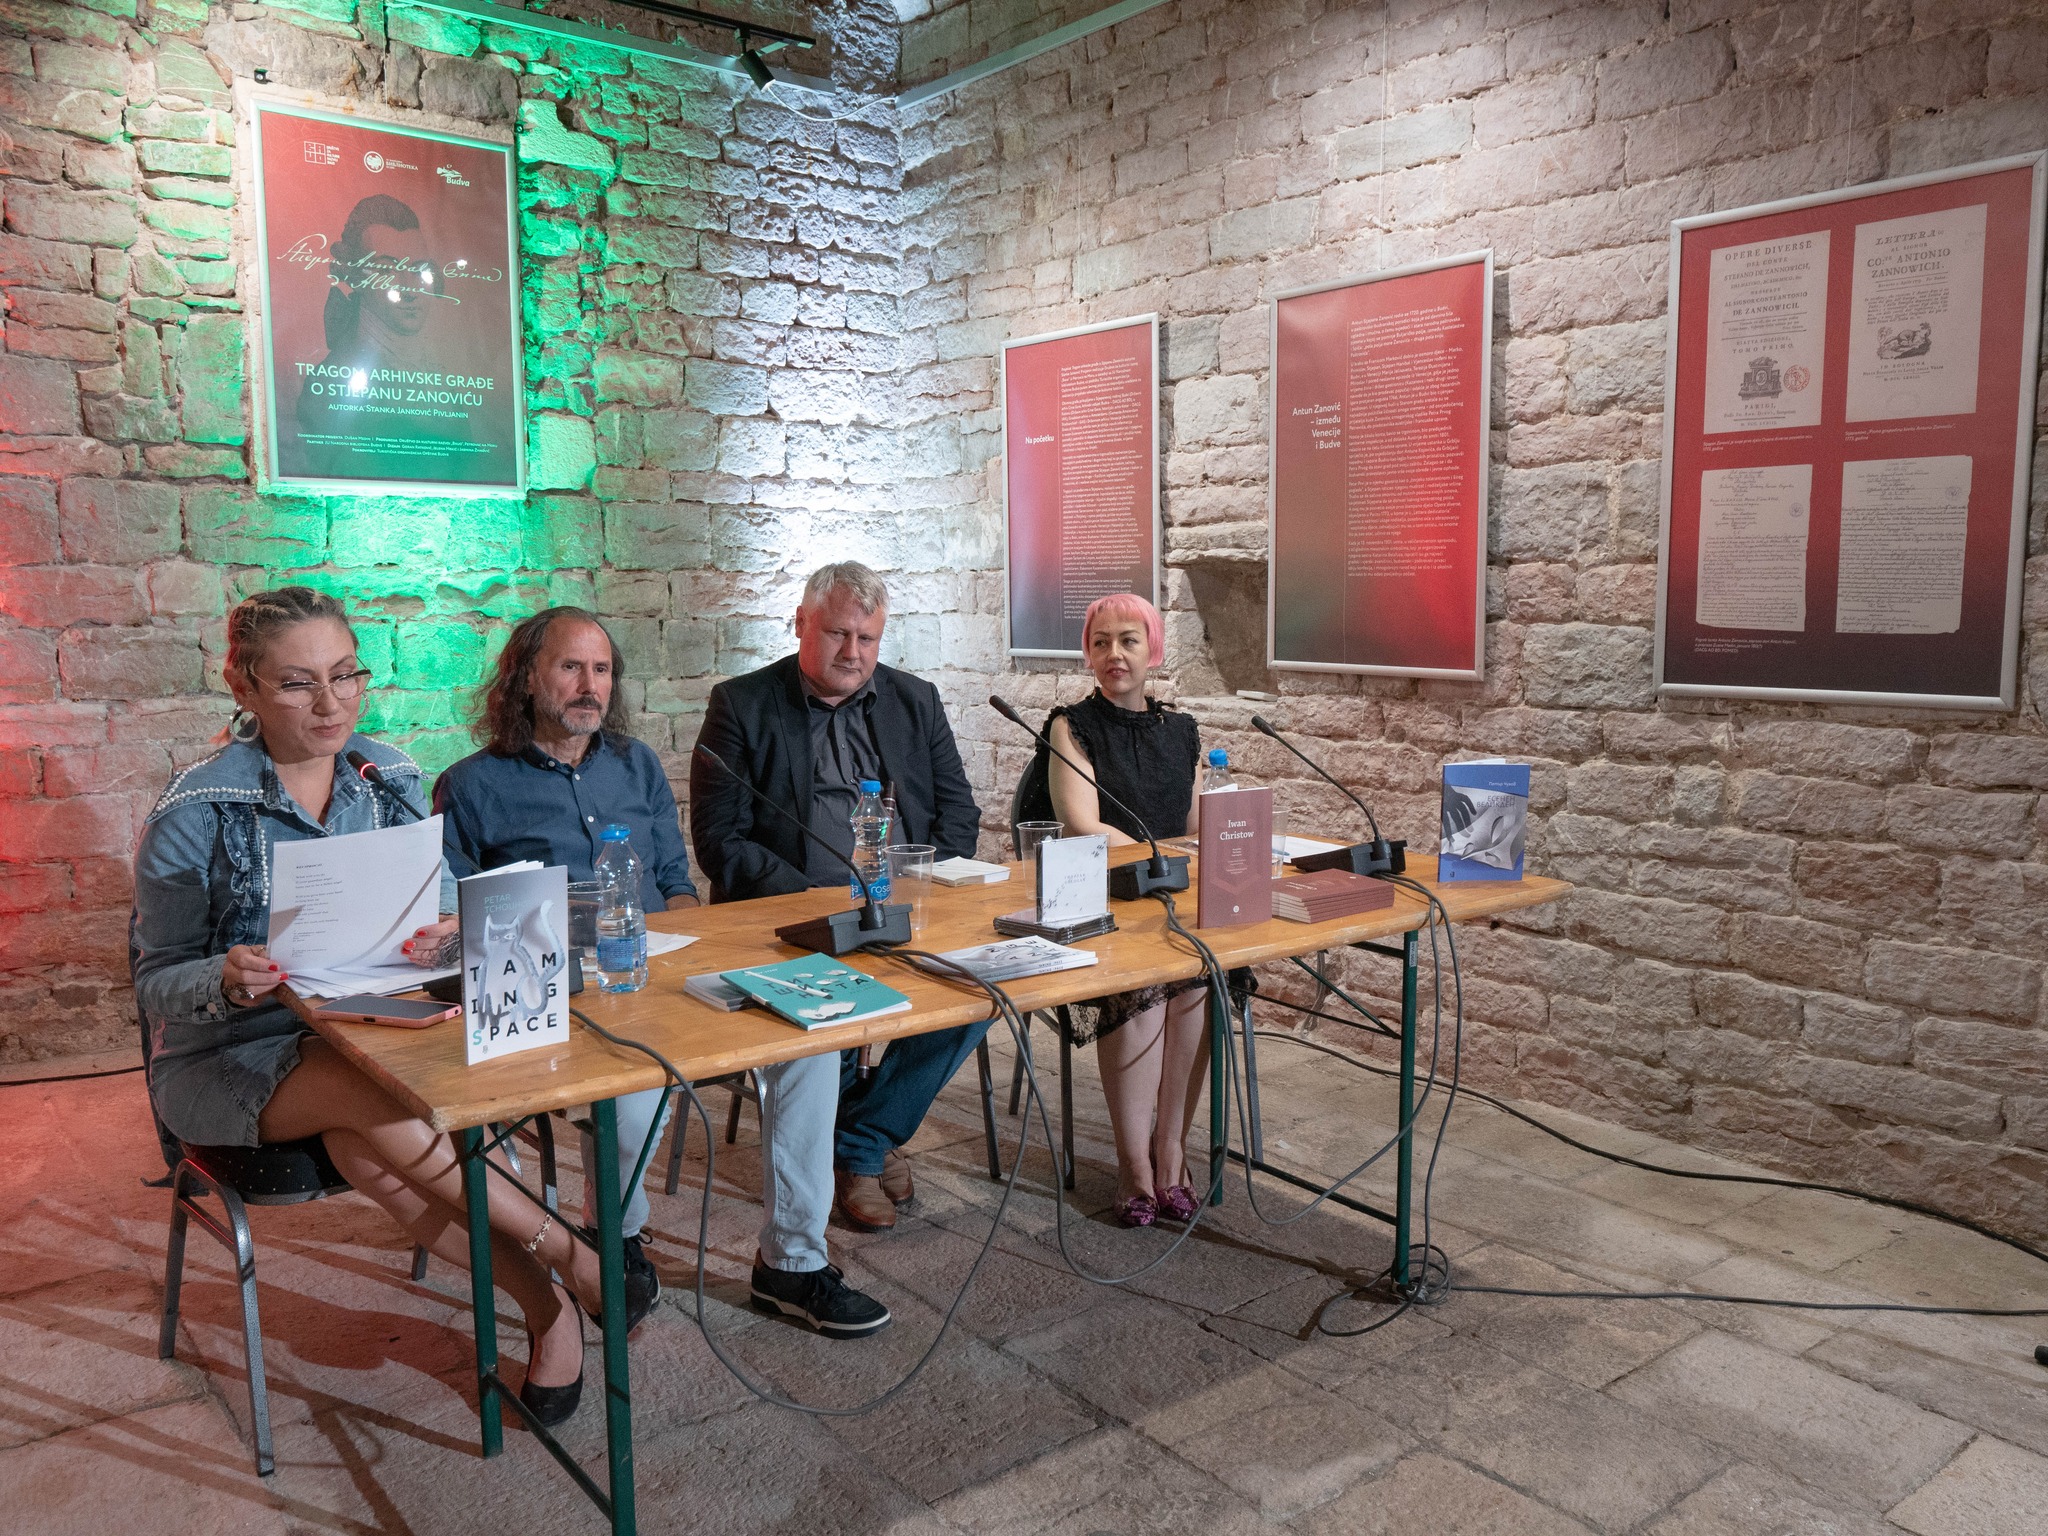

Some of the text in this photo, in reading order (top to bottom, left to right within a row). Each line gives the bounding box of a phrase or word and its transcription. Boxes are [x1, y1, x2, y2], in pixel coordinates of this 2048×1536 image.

[446, 177, 470, 187] Budva
[1875, 230, 1936, 245] LETTERA
[1725, 240, 1812, 261] OPERE DIVERSE
[1897, 248, 1951, 263] ANTONIO
[370, 368, 442, 386] ARHIVSKE
[445, 374, 494, 390] GRAĐE
[311, 382, 324, 396] O
[406, 388, 483, 406] ZANOVIĆU
[1292, 401, 1341, 416] Antun Zanović
[1316, 415, 1341, 425] između
[1311, 427, 1341, 438] Venecije
[1025, 434, 1055, 445] Na početku
[1319, 440, 1341, 449] Budve
[1227, 819, 1247, 829] Iwan
[1220, 831, 1255, 841] Christow
[870, 884, 891, 894] rosa
[484, 893, 511, 905] PETAR
[472, 1013, 558, 1046] SPACE
